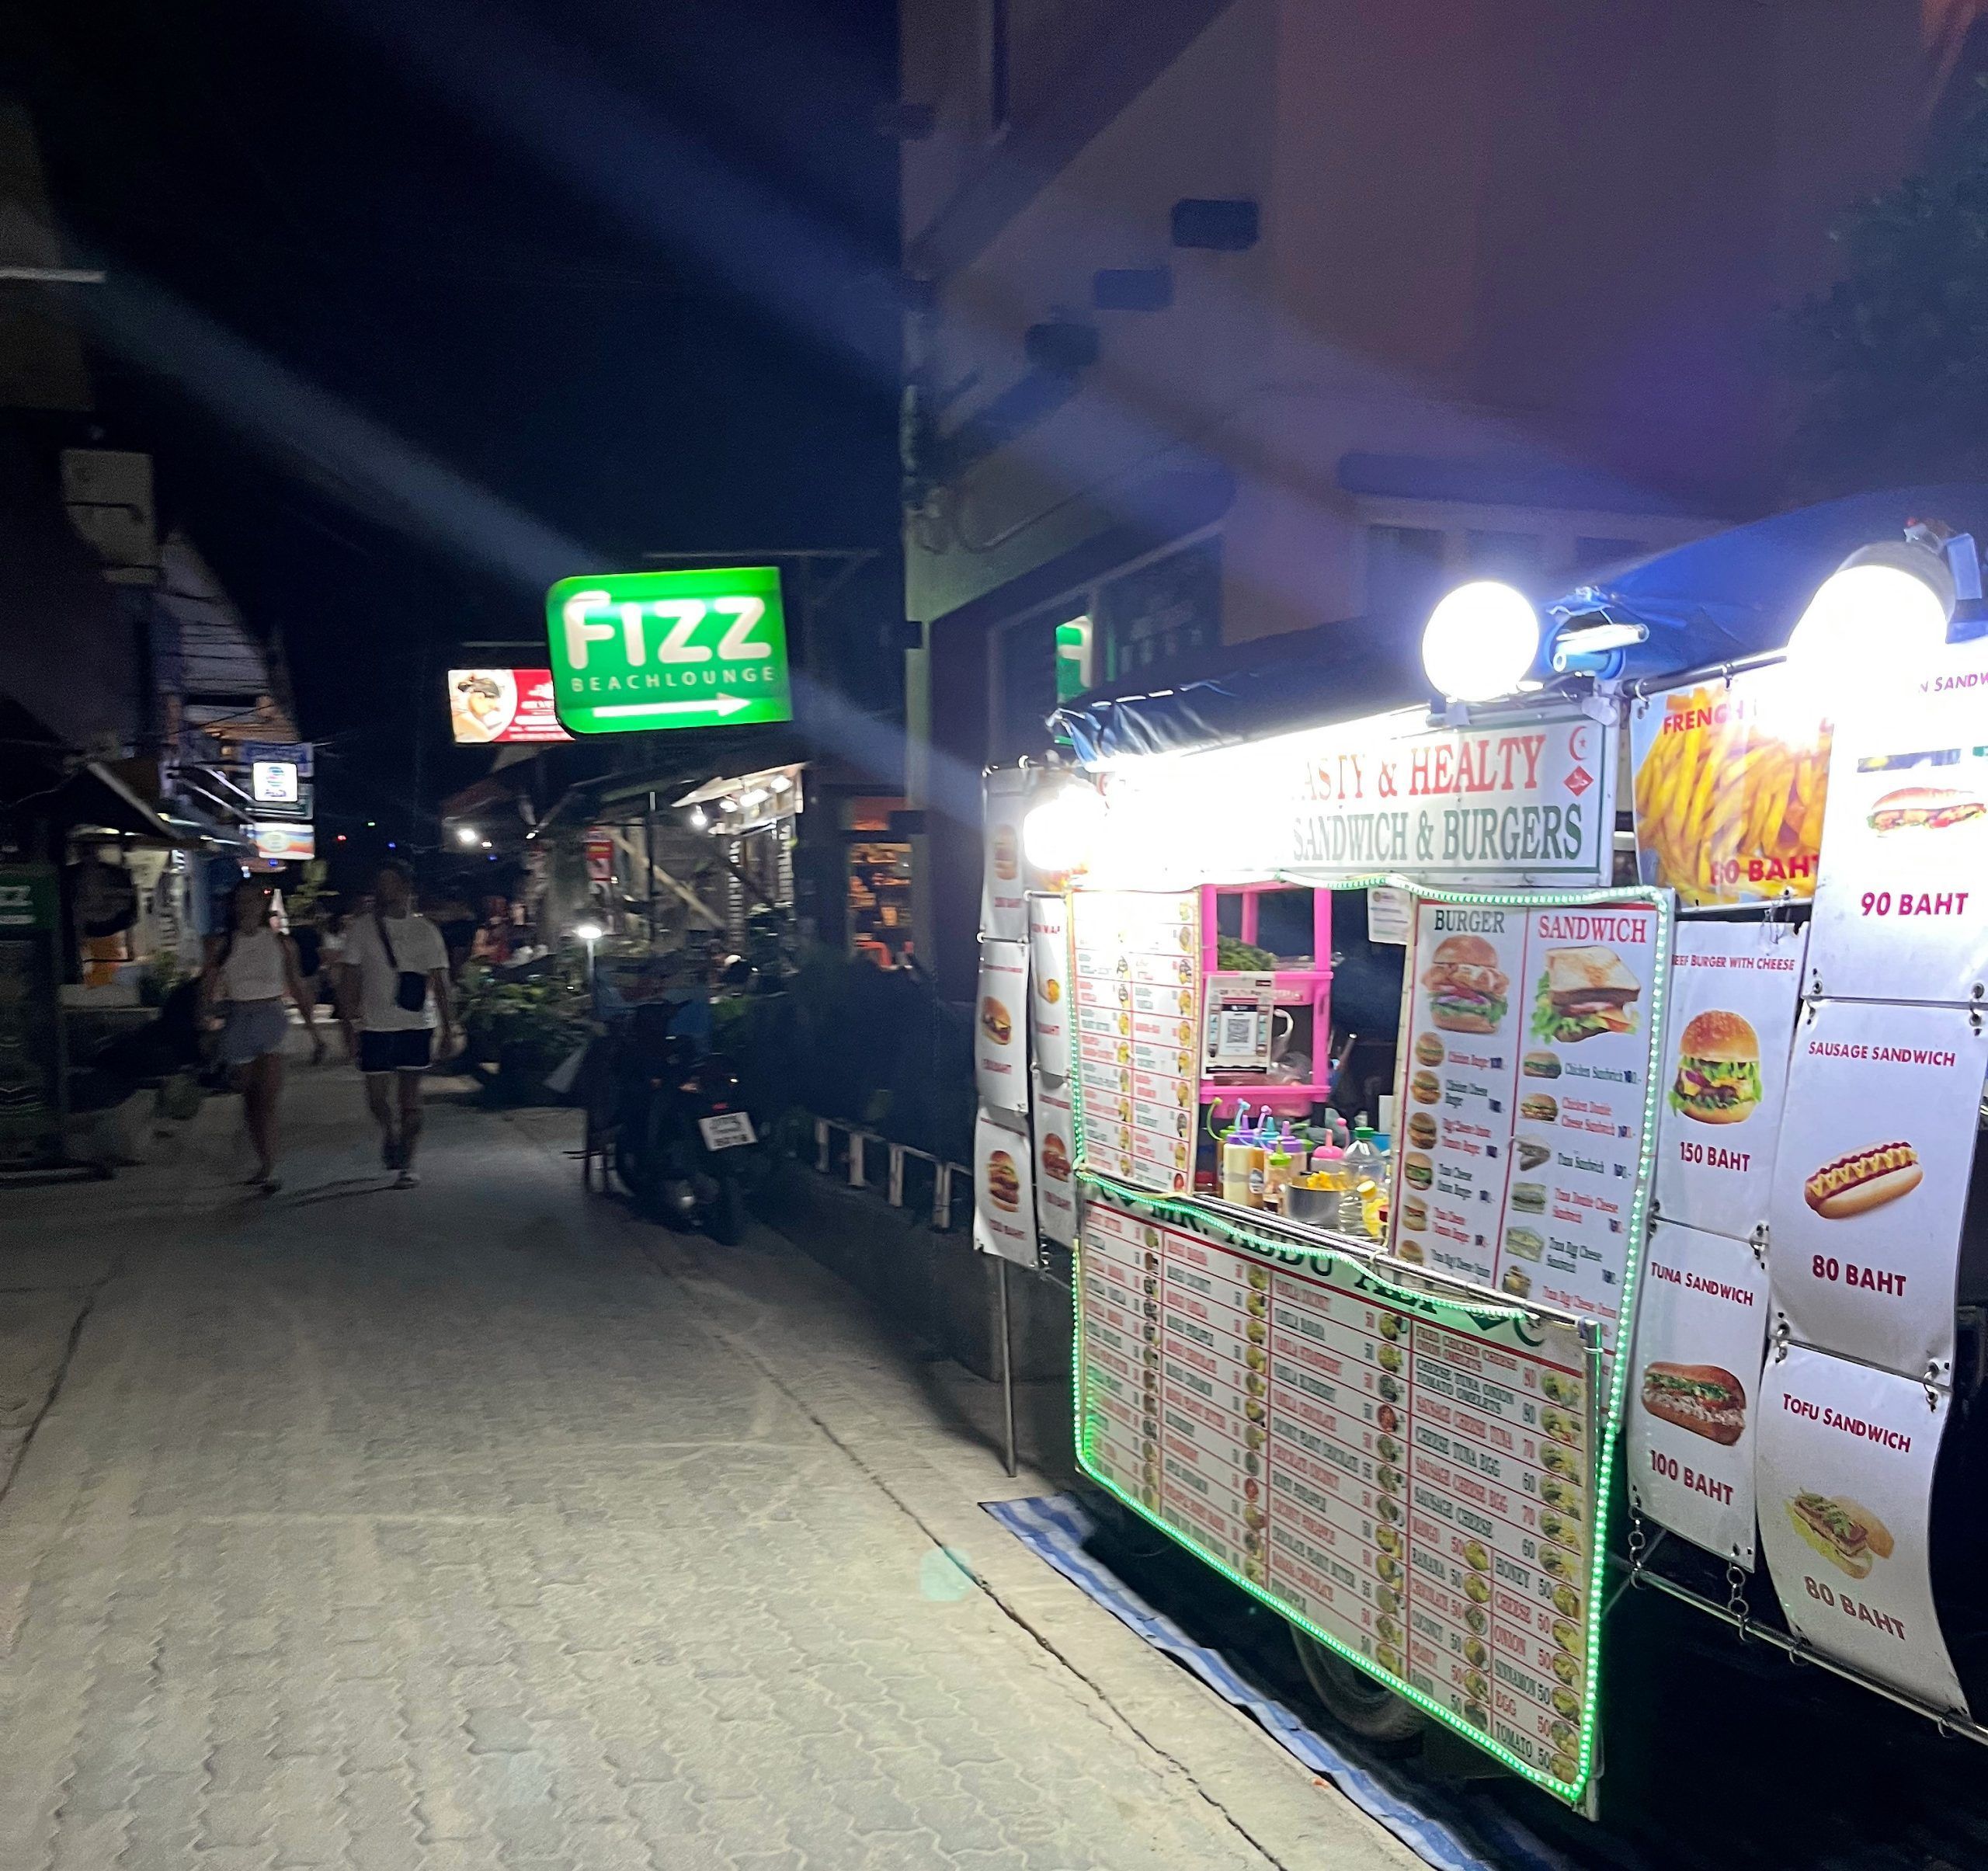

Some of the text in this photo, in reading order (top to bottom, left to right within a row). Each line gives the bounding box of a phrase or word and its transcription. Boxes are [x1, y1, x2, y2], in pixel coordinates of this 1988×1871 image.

[563, 590, 772, 669] FIZZ
[571, 666, 775, 692] BEACHLOUNGE
[1934, 672, 1988, 692] SANDW
[1292, 734, 1546, 800] ASTY & HEALTY
[1293, 803, 1583, 862] SANDWICH & BURGERS
[1434, 909, 1505, 934] BURGER
[1861, 892, 1969, 916] 90 BAHT
[1538, 915, 1647, 944] SANDWICH
[1691, 955, 1726, 968] BURGER
[1729, 956, 1755, 969] WITH
[1757, 958, 1795, 971] CHEESE
[1808, 1041, 1956, 1067] SAUSAGE SANDWICH
[1680, 1142, 1750, 1172] 150 BAHT
[1651, 1261, 1682, 1285] TUNA
[1685, 1272, 1753, 1306] SANDWICH
[1812, 1254, 1906, 1297] 80 BAHT
[1782, 1393, 1911, 1452] TOFU SANDWICH
[1650, 1449, 1733, 1506] 100 BAHT
[1495, 1556, 1552, 1599] HONEY 50
[1537, 1612, 1551, 1633] 50
[1803, 1575, 1905, 1641] 80 BAHT
[1495, 1688, 1551, 1737] EGG 50
[1537, 1681, 1551, 1705] 50
[1496, 1720, 1551, 1770] TOMATO 50
